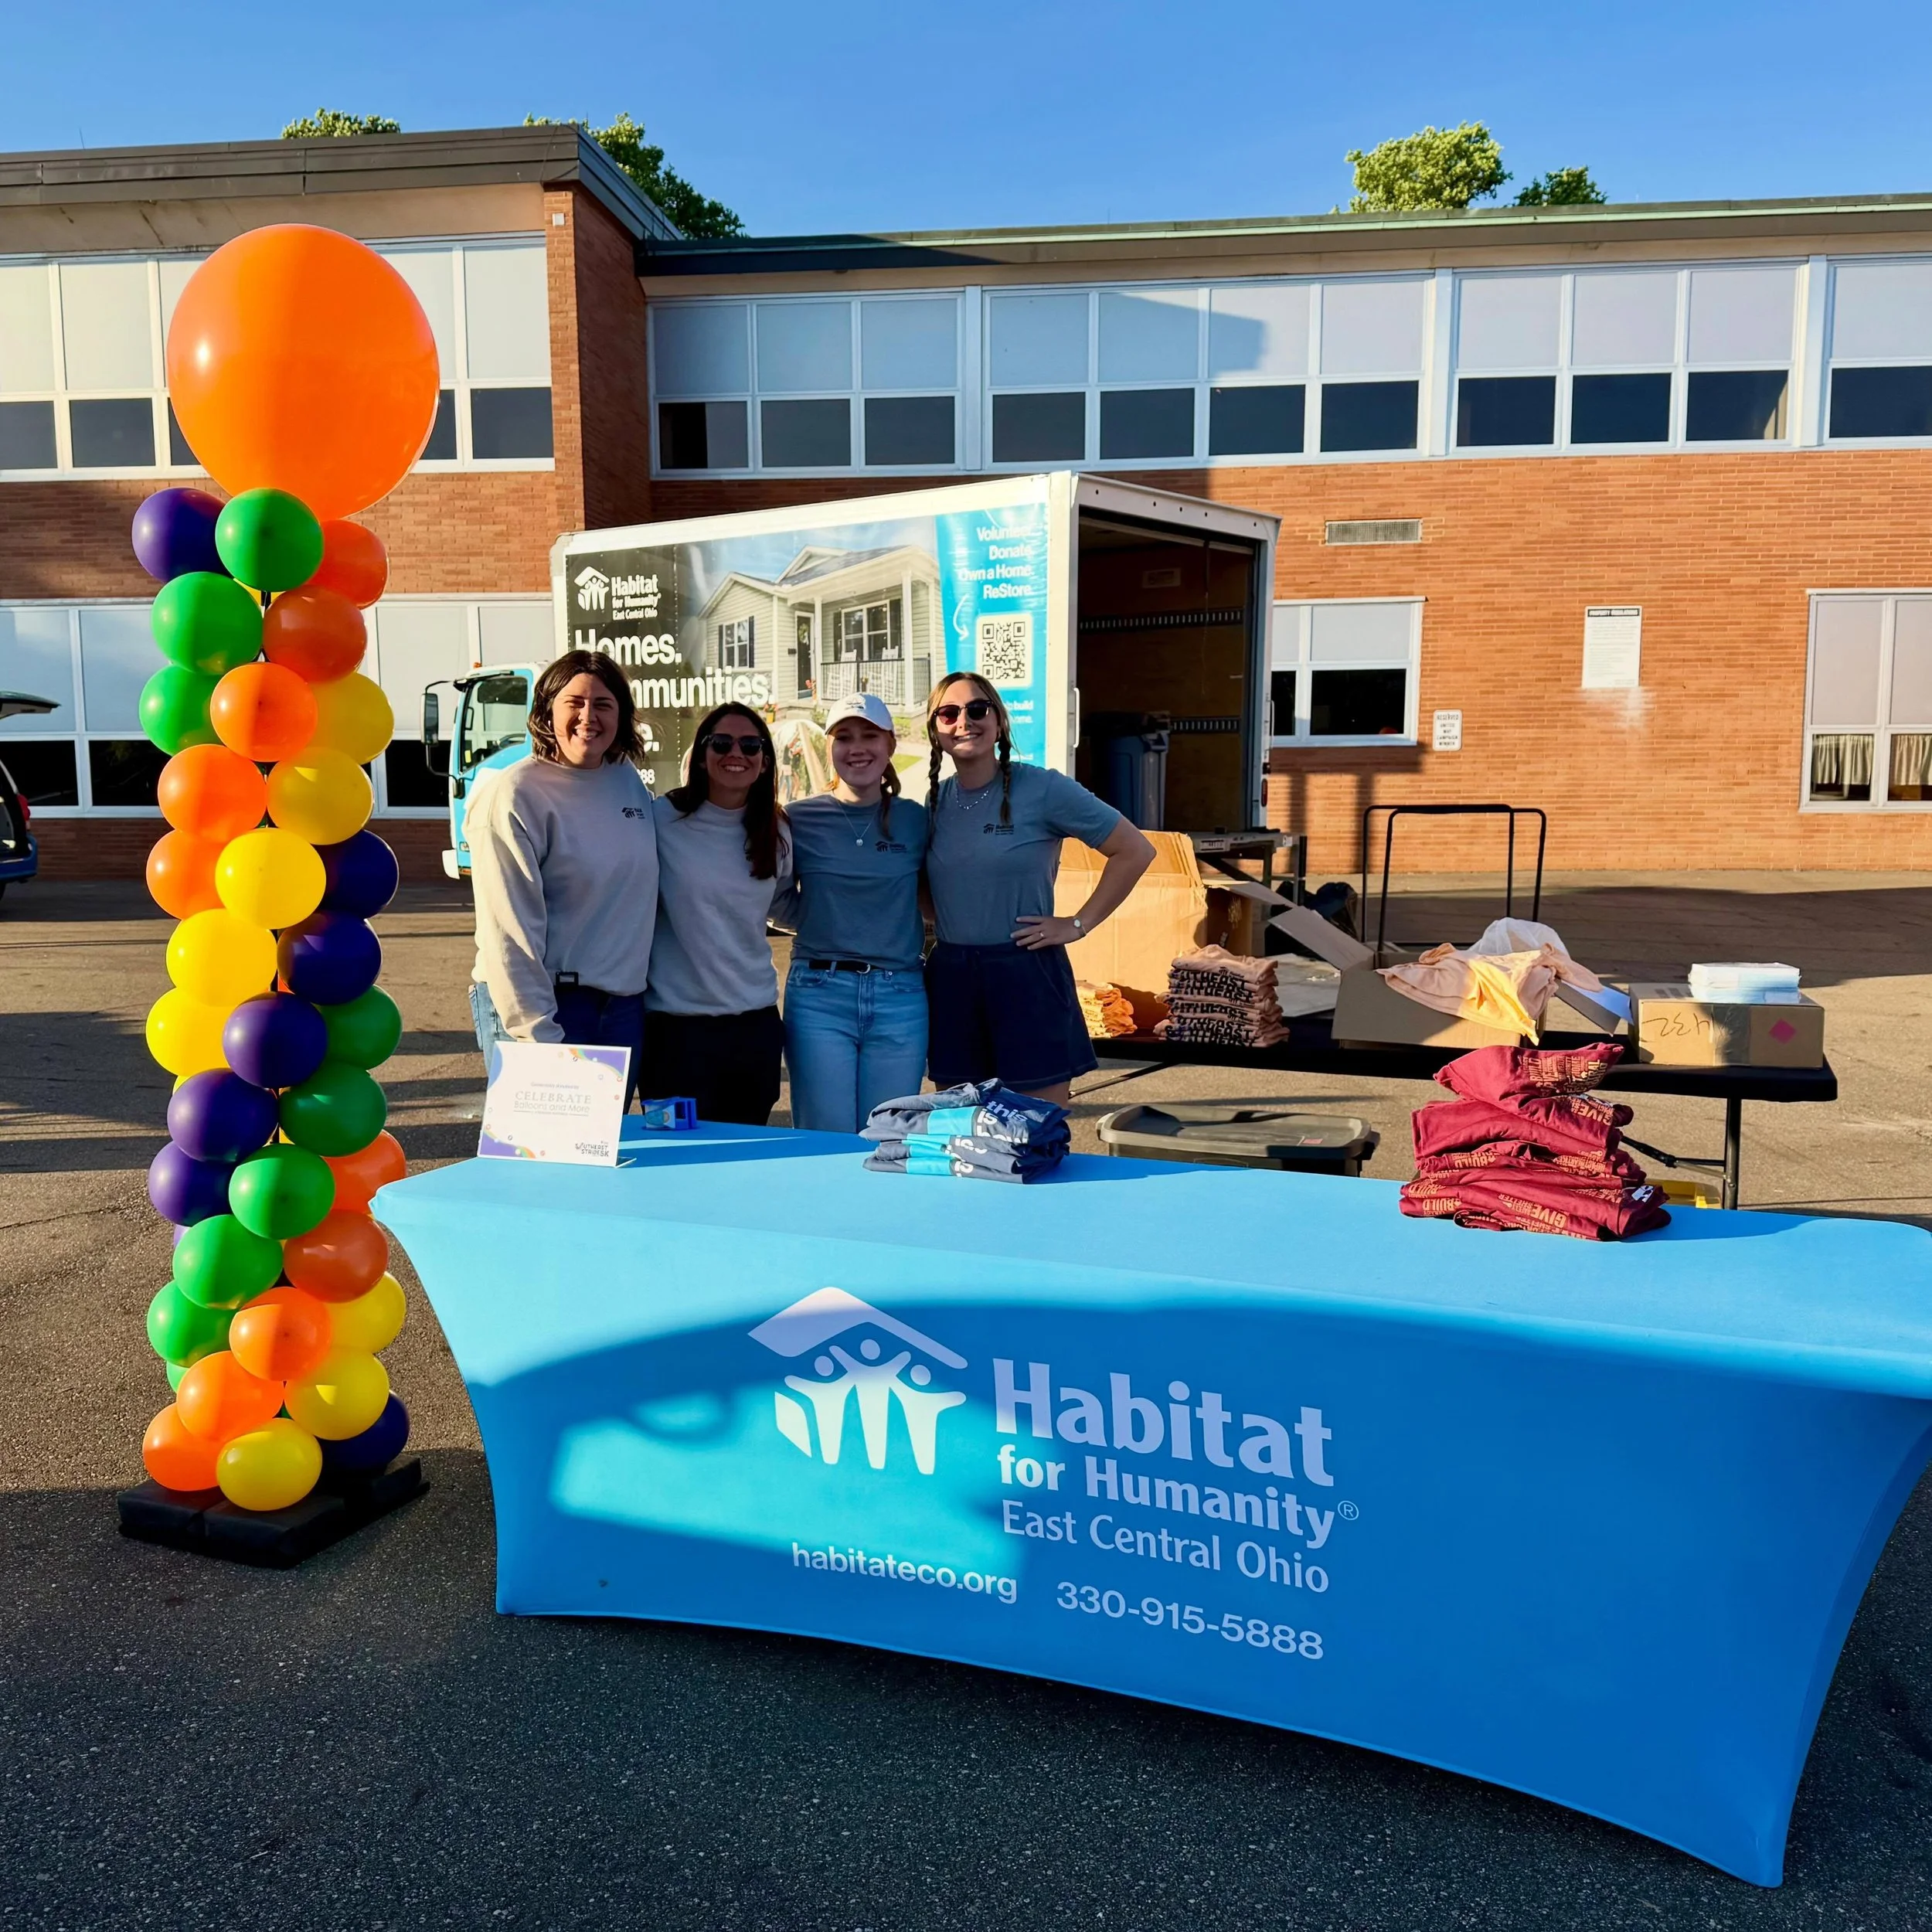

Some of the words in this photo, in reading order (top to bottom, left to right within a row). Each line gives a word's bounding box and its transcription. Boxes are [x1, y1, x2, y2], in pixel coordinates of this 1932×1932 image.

[958, 568, 985, 580] Own
[987, 568, 995, 580] a
[995, 563, 1035, 579] Home.
[611, 574, 658, 596] Habitat
[983, 583, 1034, 599] ReStore.
[575, 628, 682, 665] Homes.
[630, 665, 774, 709] munities.
[1641, 1012, 1709, 1037] 432
[1529, 1057, 1543, 1081] BUILD
[514, 1100, 547, 1111] Balloons
[568, 1104, 590, 1113] More
[515, 1091, 591, 1104] CELEBRATE
[977, 1108, 998, 1125] is
[986, 1100, 1028, 1122] this
[1577, 1102, 1613, 1126] GIVE
[1408, 1185, 1439, 1194] BUILD
[1498, 1193, 1533, 1209] SHELTER
[1596, 1192, 1621, 1204] IVE
[1423, 1198, 1454, 1211] BUILD
[1529, 1204, 1567, 1229] GIVE
[992, 1357, 1335, 1487] Habitat
[997, 1444, 1065, 1492] for
[1085, 1454, 1335, 1549] Humanity
[1003, 1499, 1077, 1545] East
[1090, 1515, 1220, 1572] Central
[1237, 1541, 1329, 1594] Ohio
[792, 1542, 1018, 1605] habitateco.org
[1056, 1581, 1325, 1661] 330-915-5888
